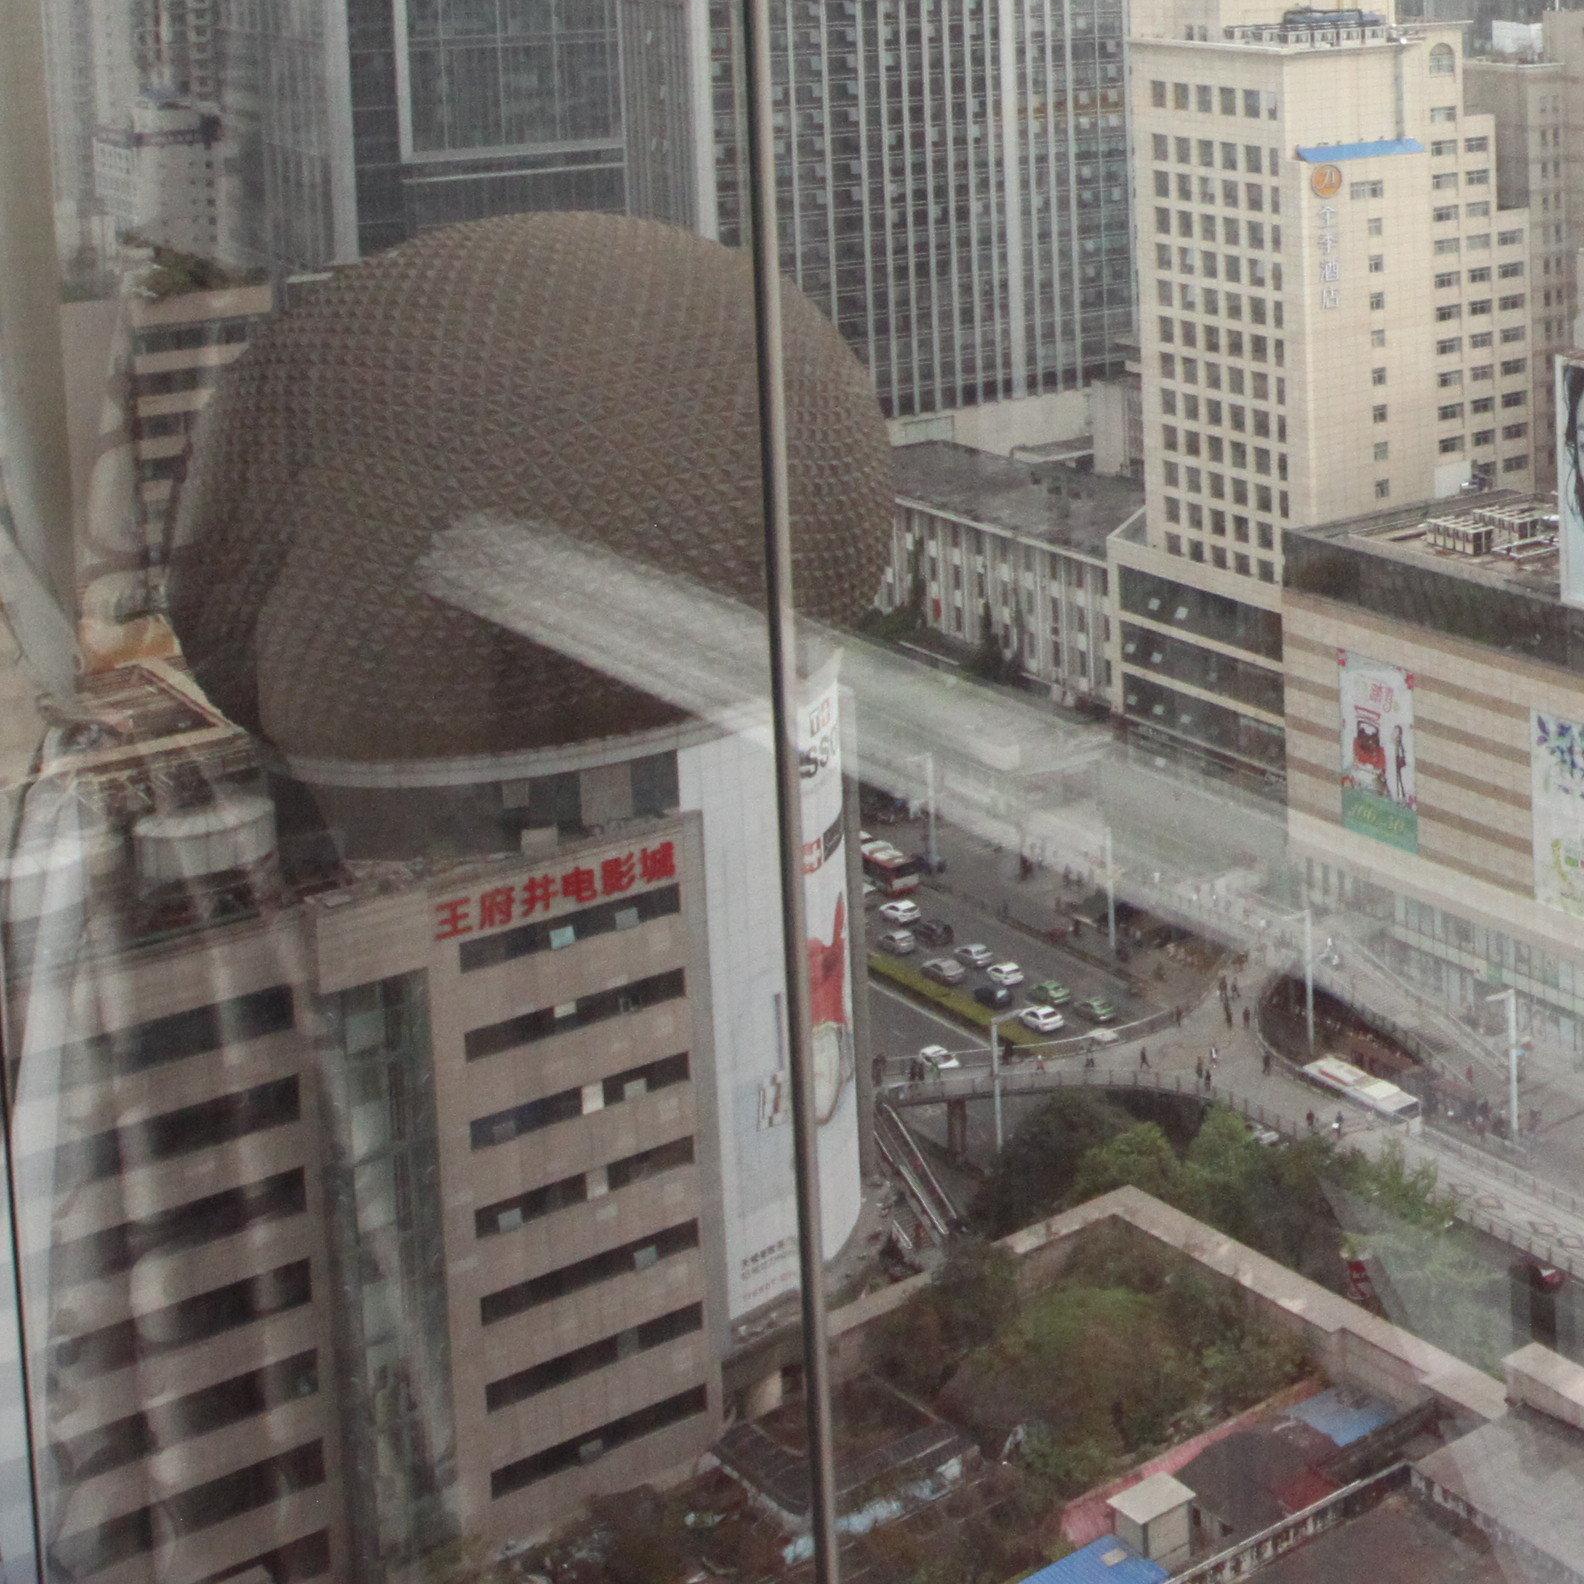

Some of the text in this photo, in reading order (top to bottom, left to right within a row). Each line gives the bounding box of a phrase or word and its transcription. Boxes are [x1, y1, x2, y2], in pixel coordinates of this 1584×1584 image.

[433, 840, 677, 942] 王府井电影城
